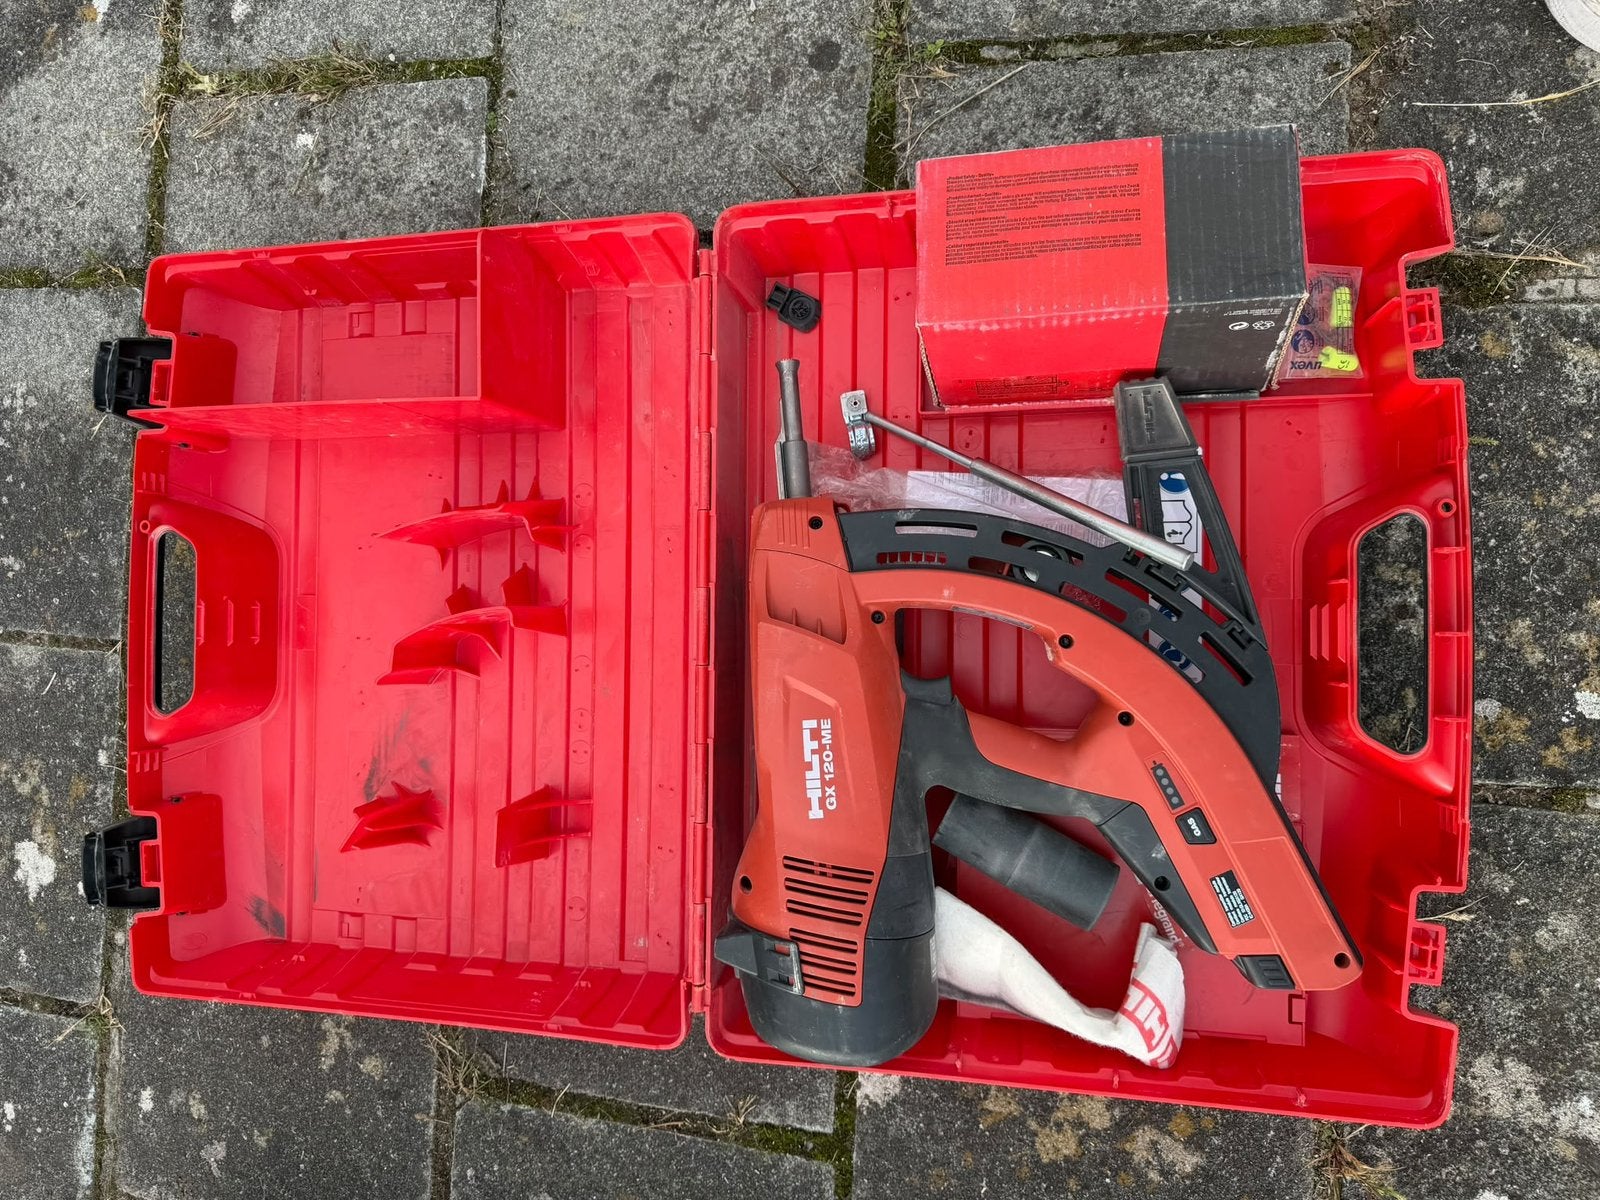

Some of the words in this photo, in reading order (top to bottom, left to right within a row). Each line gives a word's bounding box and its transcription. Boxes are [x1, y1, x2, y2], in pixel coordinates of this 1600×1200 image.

[1290, 361, 1323, 370] uvex
[821, 719, 834, 781] 120-ME
[802, 719, 823, 819] HILTI
[824, 785, 837, 810] GX
[1187, 816, 1202, 837] GAS
